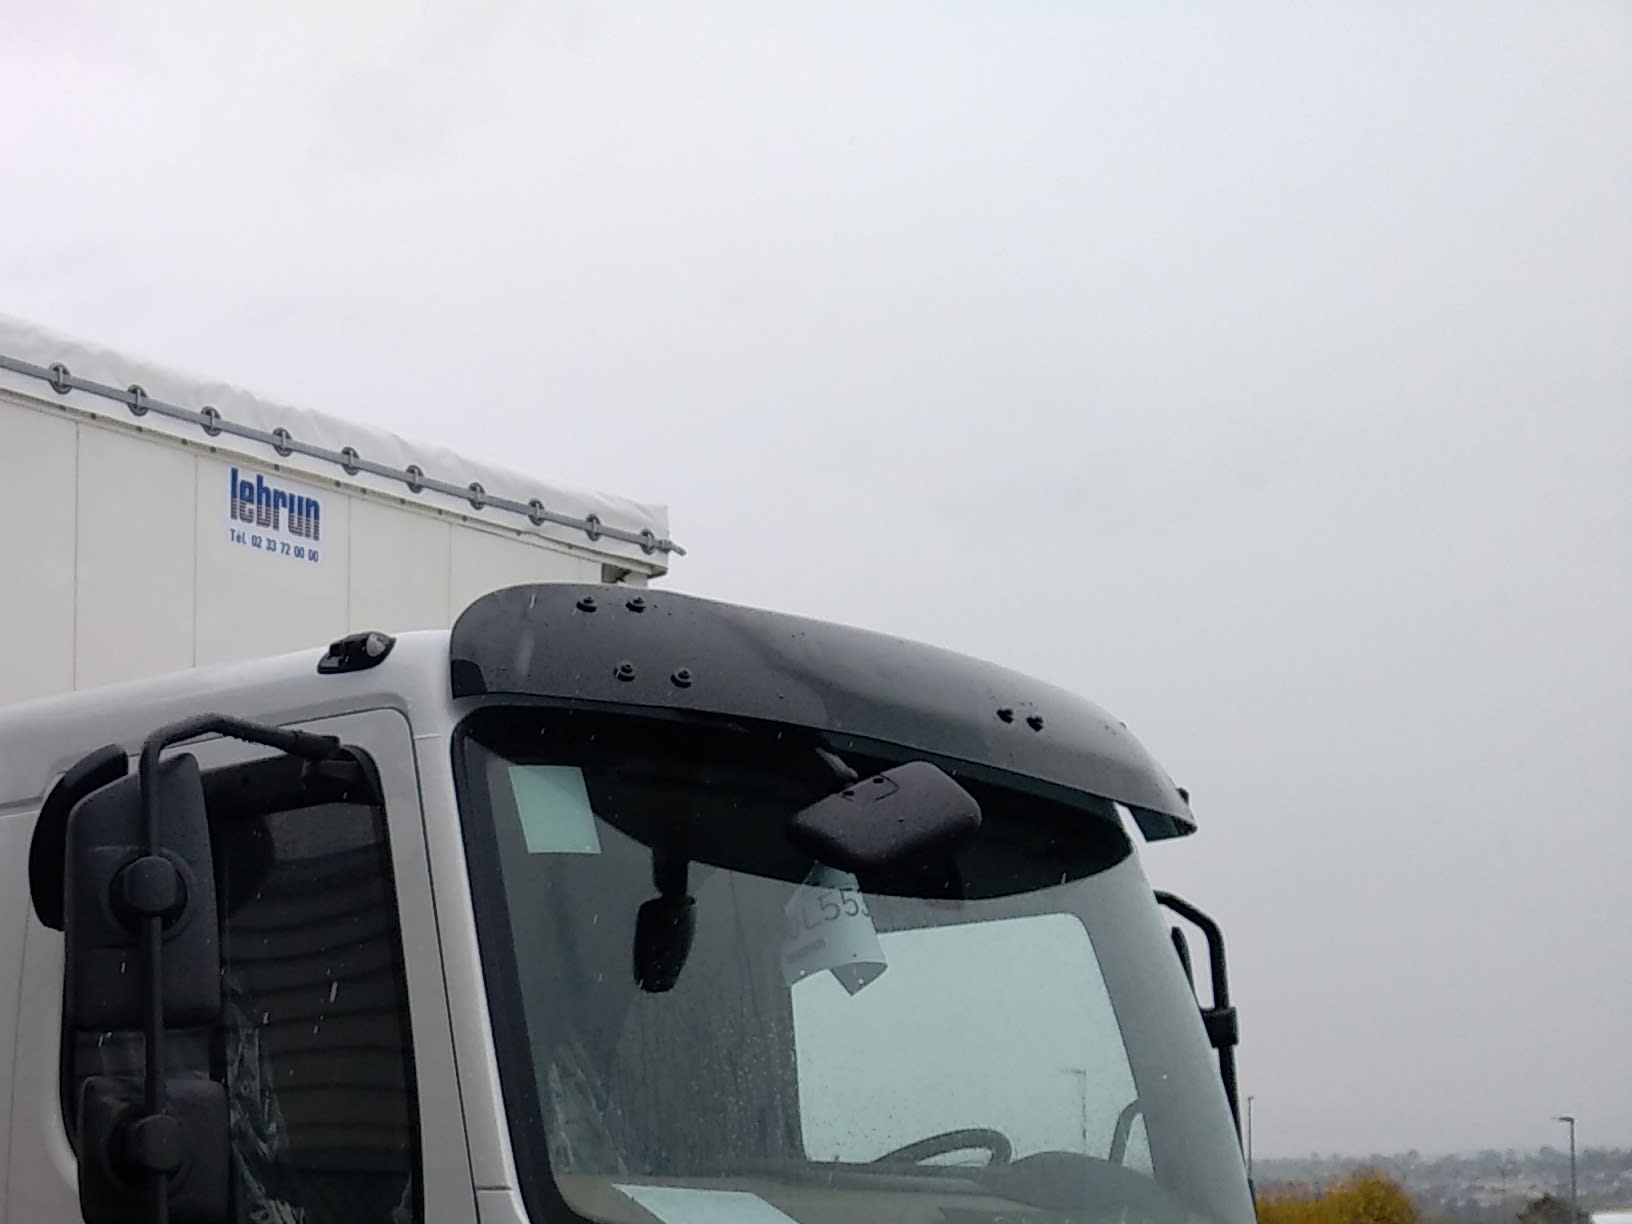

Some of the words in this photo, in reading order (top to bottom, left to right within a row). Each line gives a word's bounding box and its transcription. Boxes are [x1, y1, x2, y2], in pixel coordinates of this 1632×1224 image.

[230, 467, 320, 541] lebrun
[251, 534, 263, 549] 02
[266, 538, 277, 553] 33
[279, 542, 291, 556] 72
[308, 549, 319, 562] 00
